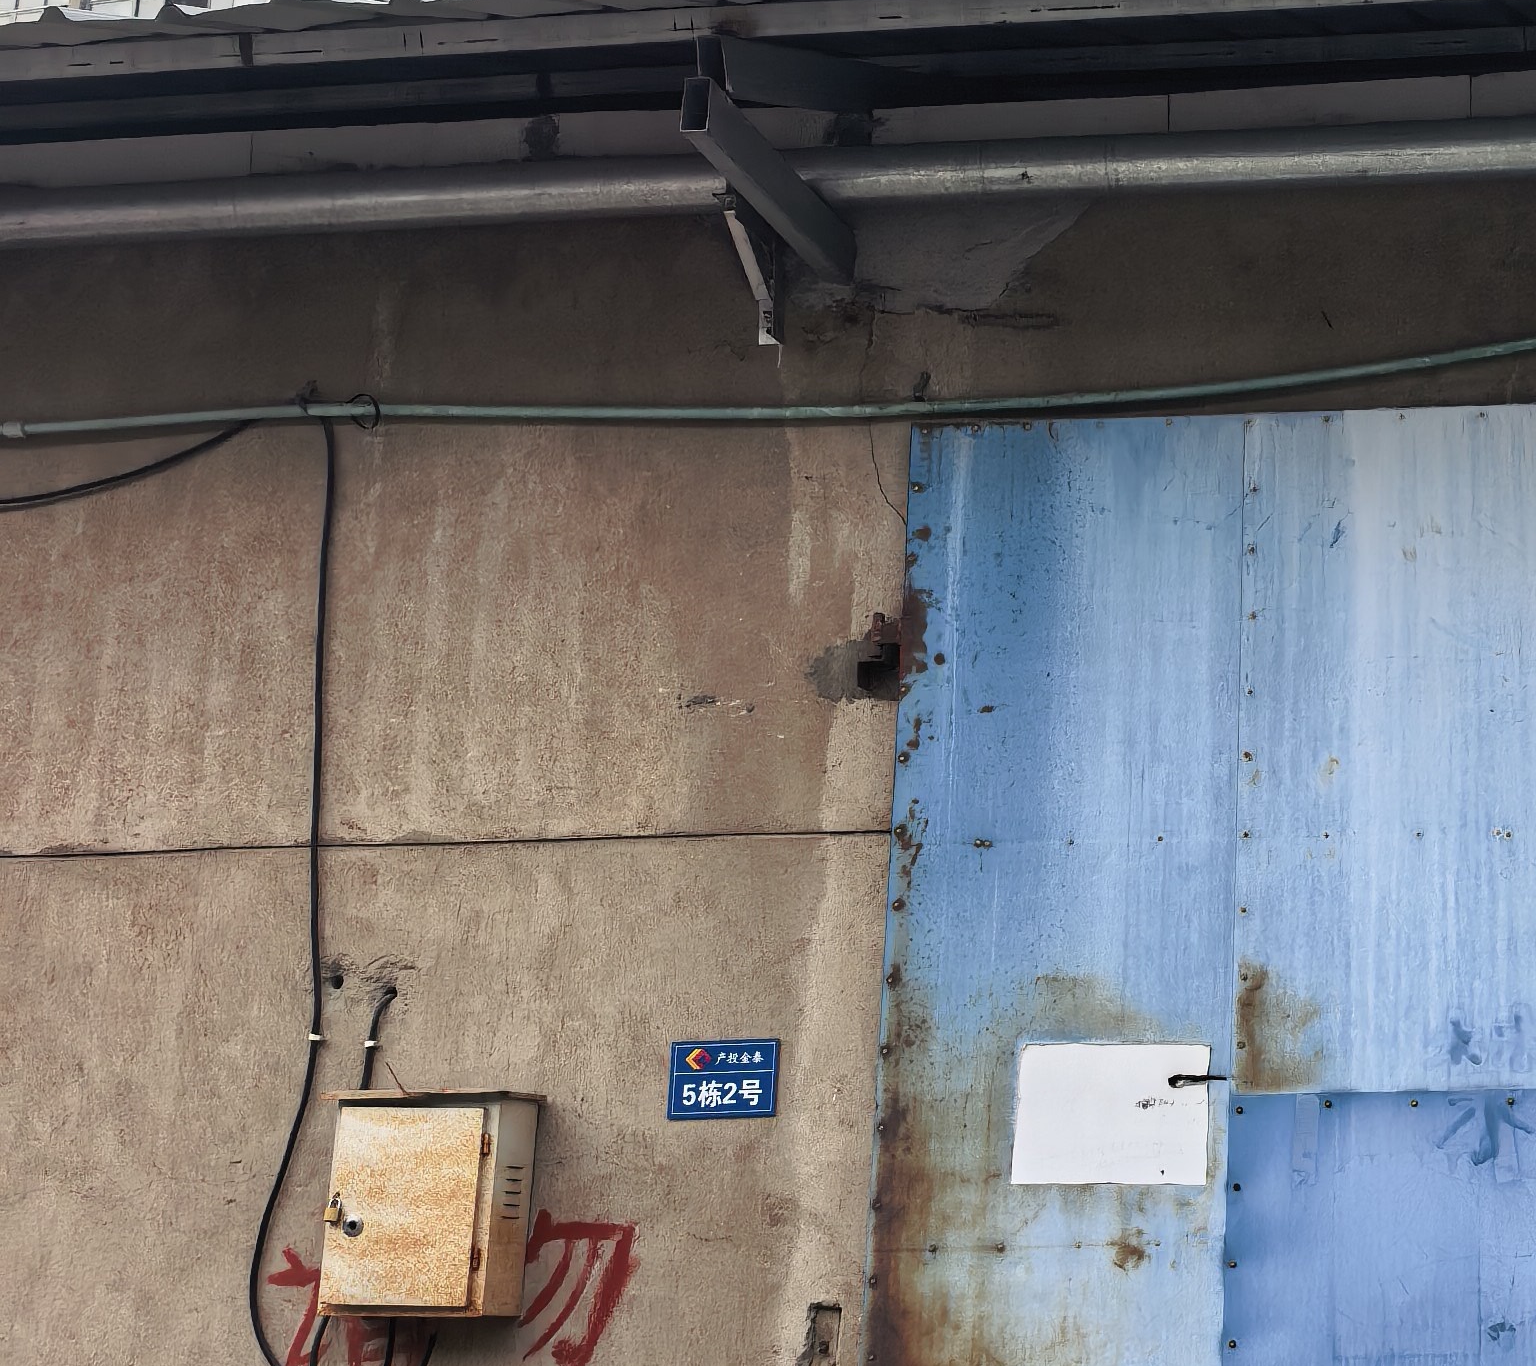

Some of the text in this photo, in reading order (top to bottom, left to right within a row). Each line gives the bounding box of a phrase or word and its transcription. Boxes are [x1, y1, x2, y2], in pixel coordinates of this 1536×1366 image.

[715, 1050, 764, 1065] 产投金泰
[682, 1079, 763, 1108] 5栋2号
